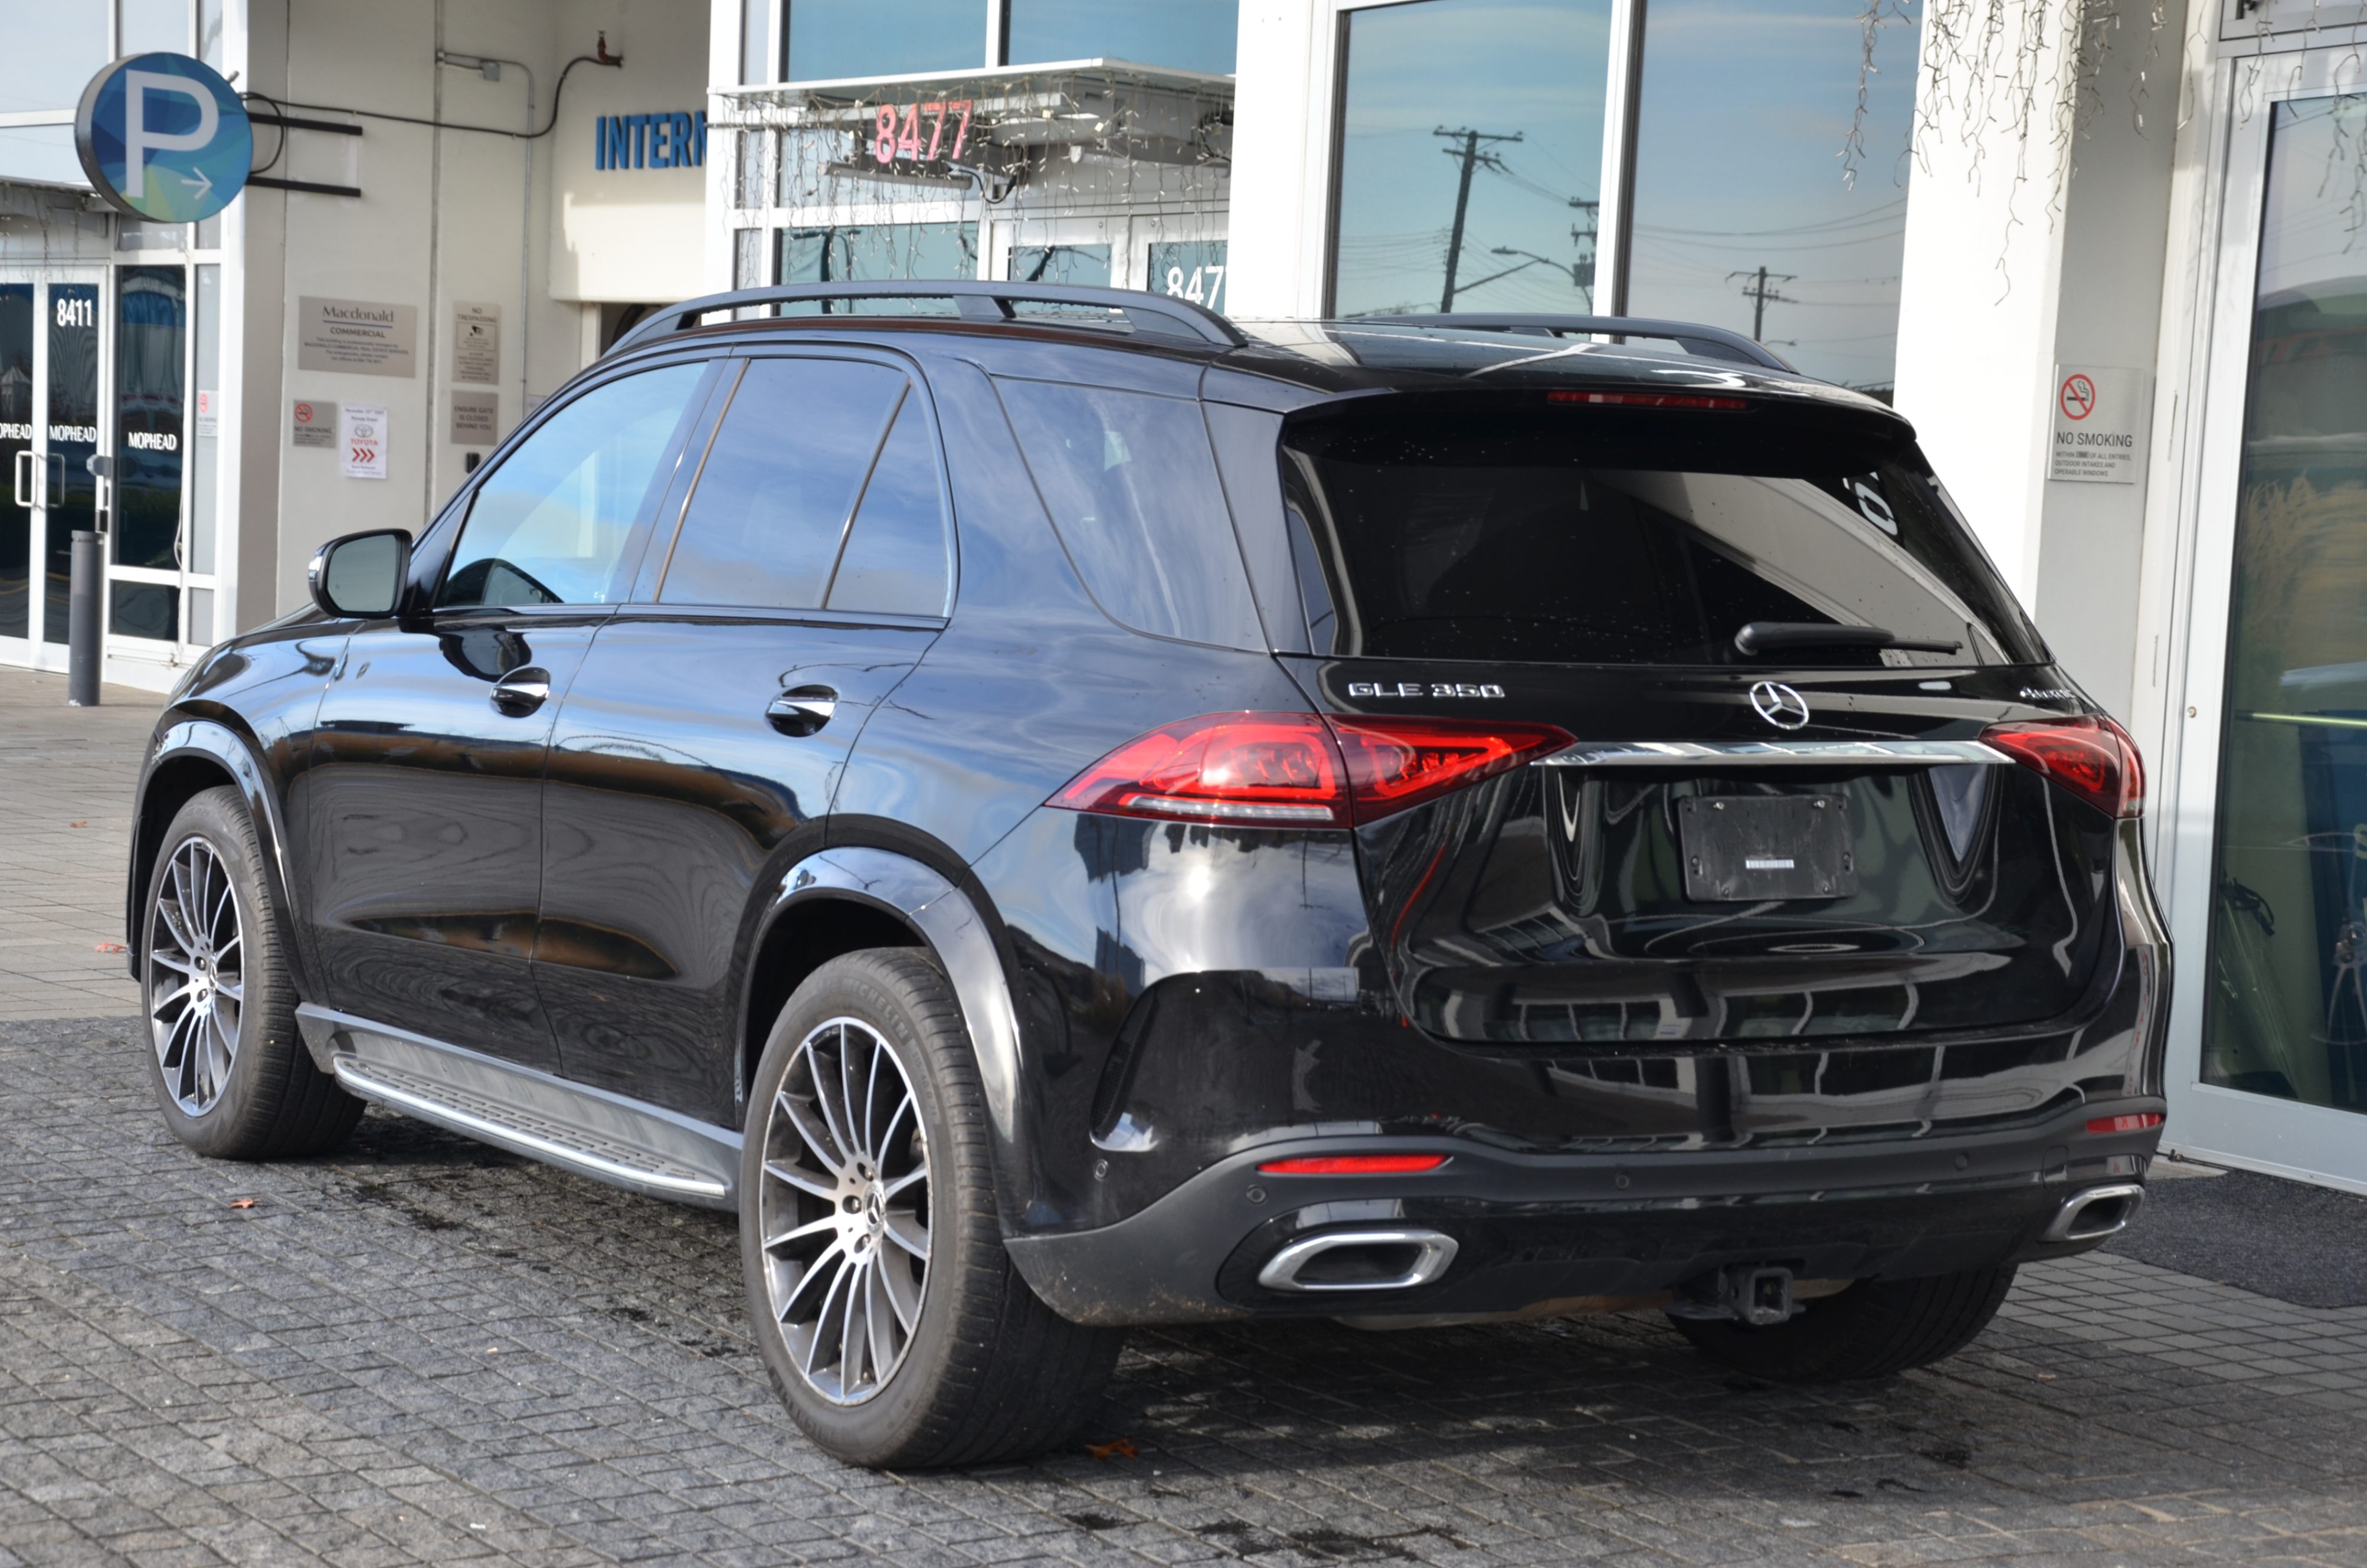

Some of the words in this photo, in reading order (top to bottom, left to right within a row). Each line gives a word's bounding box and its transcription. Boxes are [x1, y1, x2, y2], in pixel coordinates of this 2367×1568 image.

[126, 69, 219, 198] P
[876, 99, 973, 163] 8477
[1167, 266, 1226, 309] 847
[57, 299, 92, 326] 8411
[322, 305, 394, 322] Macdonald
[457, 314, 497, 323] TRESPASSING
[330, 327, 386, 338] COMMERCIAL
[0, 423, 32, 440] OPHEAD
[49, 425, 96, 443] MOPHEAD
[2057, 431, 2074, 444] NO
[2077, 433, 2132, 447] SMOKING
[128, 432, 177, 450] MOPHEAD
[1348, 682, 1423, 697] GLE
[1431, 683, 1505, 698] 350
[840, 978, 909, 1040] MICHELIN
